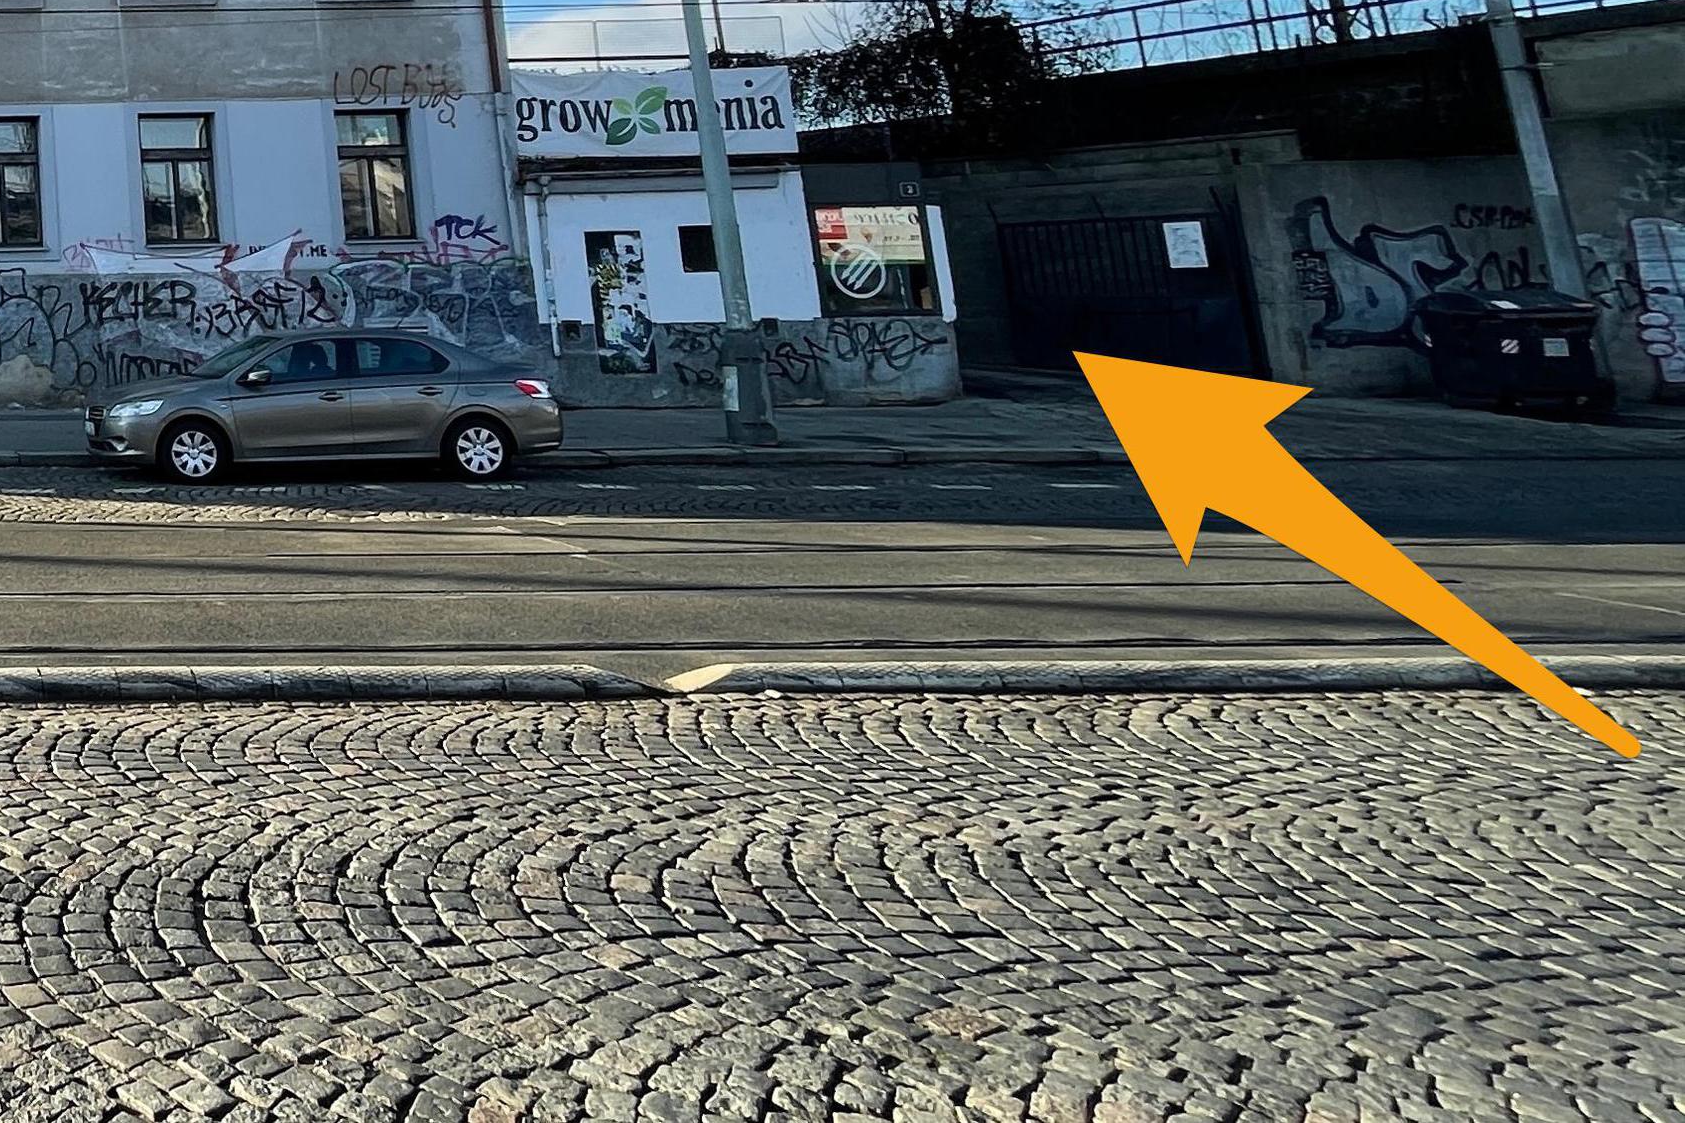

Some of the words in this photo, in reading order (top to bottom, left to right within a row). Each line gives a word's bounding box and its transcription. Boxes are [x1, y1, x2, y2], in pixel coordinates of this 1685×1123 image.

[334, 65, 396, 105] LOST
[516, 97, 612, 142] grow
[665, 79, 785, 133] mnia
